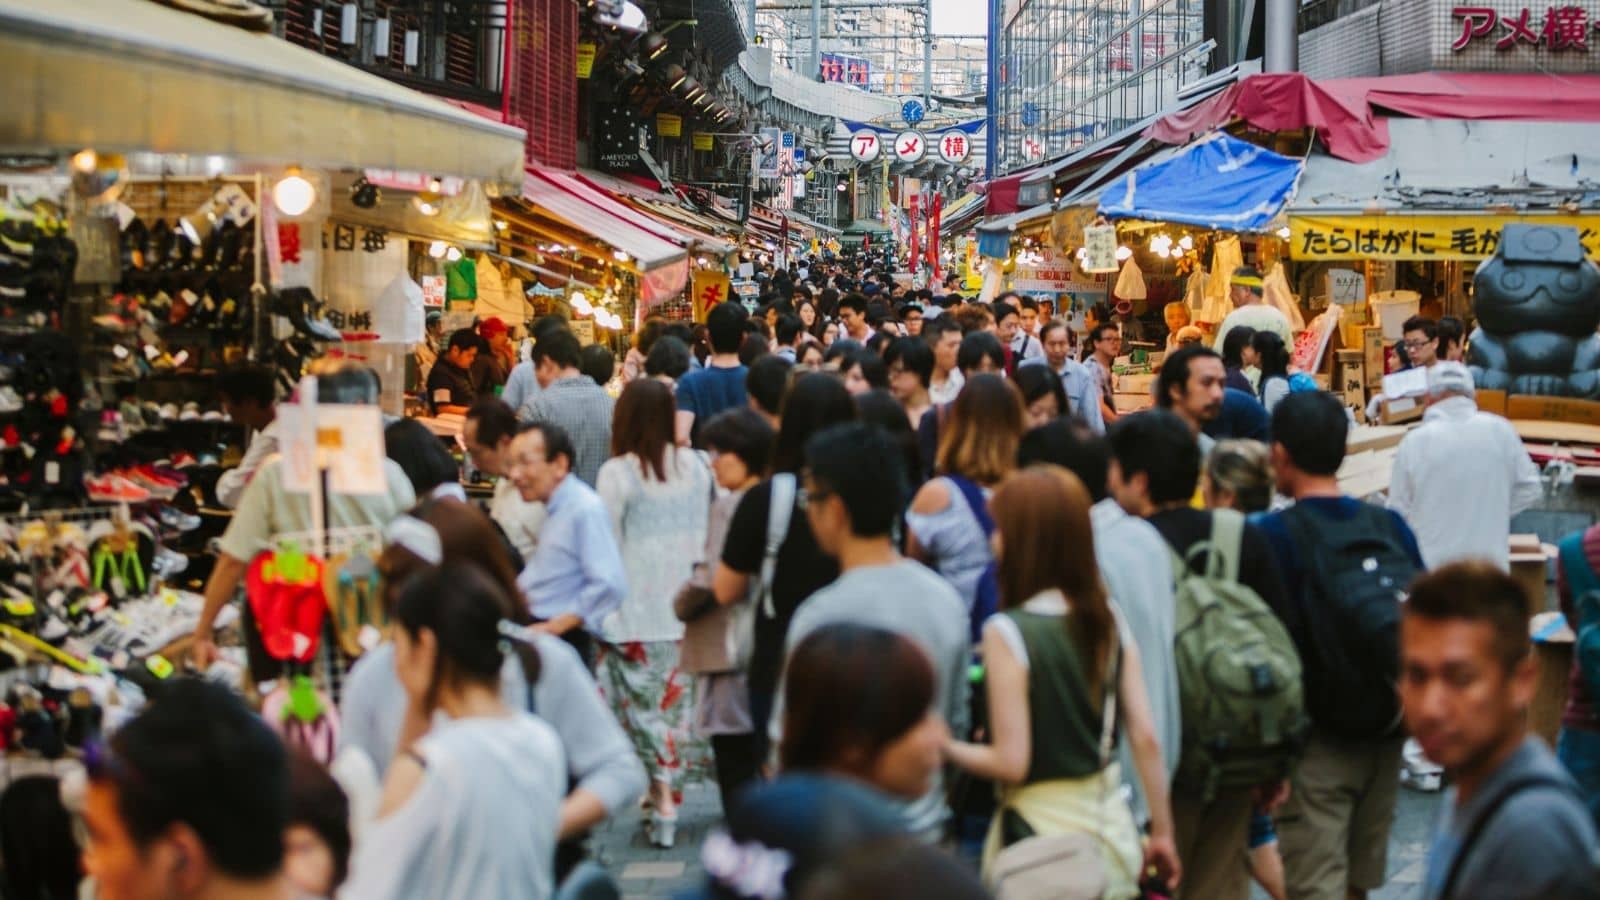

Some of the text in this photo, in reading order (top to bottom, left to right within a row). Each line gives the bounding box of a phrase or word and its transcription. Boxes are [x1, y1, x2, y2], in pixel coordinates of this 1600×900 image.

[1452, 6, 1600, 50] アメ横
[601, 152, 639, 161] AMEYOKO
[856, 136, 965, 157] アメ横
[609, 160, 630, 169] PLAZA
[1301, 227, 1435, 255] たらばがに
